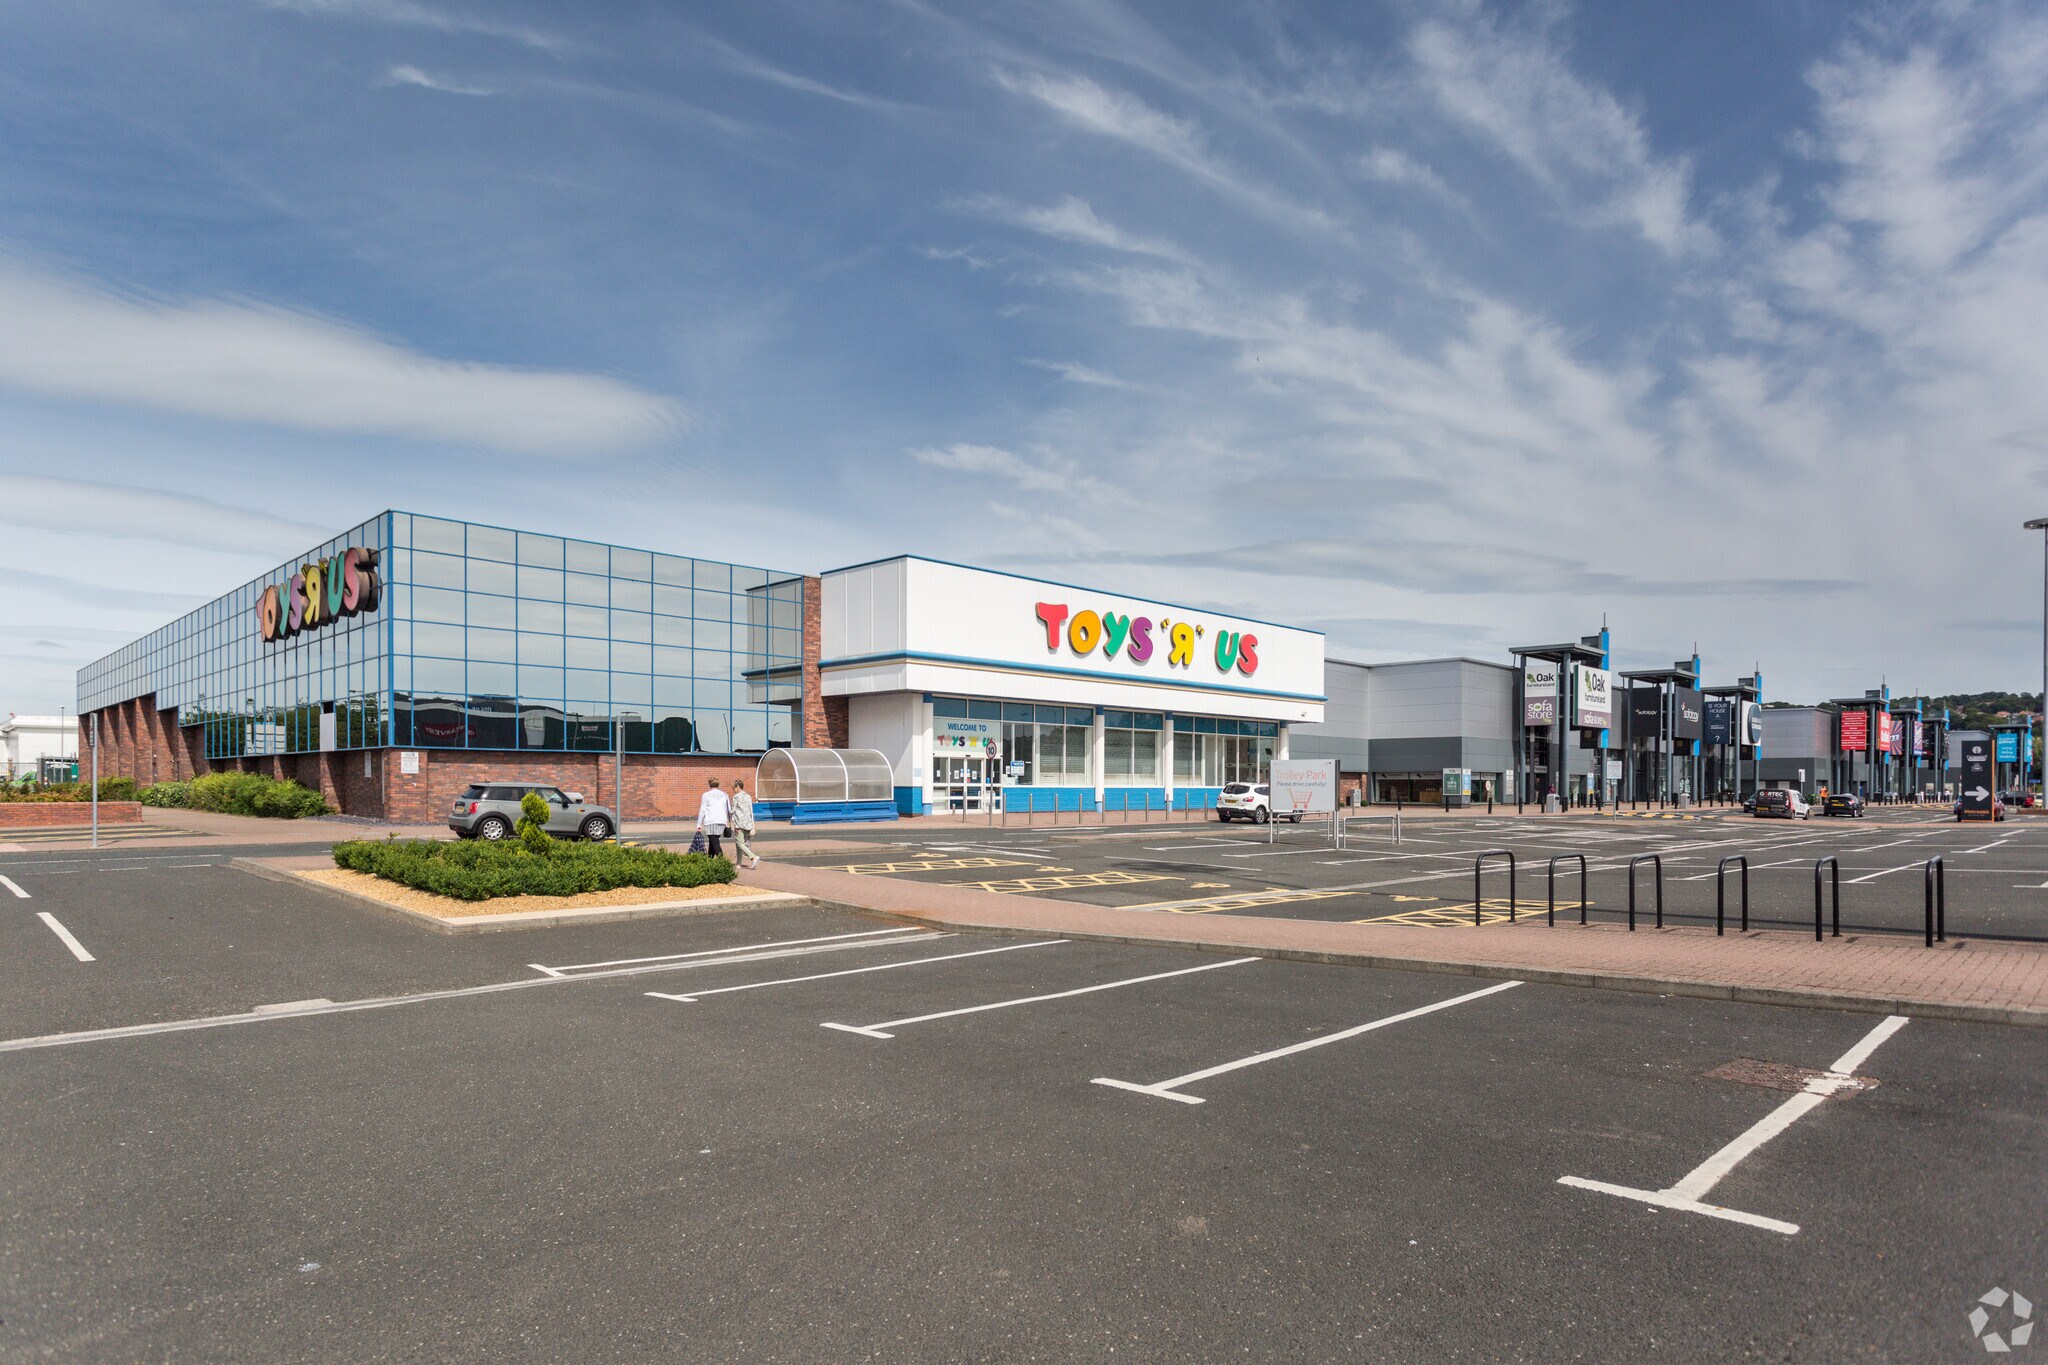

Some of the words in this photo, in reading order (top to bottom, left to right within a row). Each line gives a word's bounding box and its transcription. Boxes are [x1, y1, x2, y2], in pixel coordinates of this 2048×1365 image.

[256, 574, 304, 641] TOYS
[327, 547, 369, 616] US
[1035, 601, 1153, 661] TOYS
[1214, 629, 1258, 674] US
[1536, 673, 1554, 682] Oak
[1592, 673, 1605, 693] Oak
[1528, 700, 1553, 712] sofa
[1528, 711, 1553, 719] store
[947, 723, 977, 732] WELCOME
[937, 734, 965, 747] TOYS
[987, 746, 995, 755] 10
[1276, 769, 1304, 781] Trolley
[1306, 770, 1327, 780] Park
